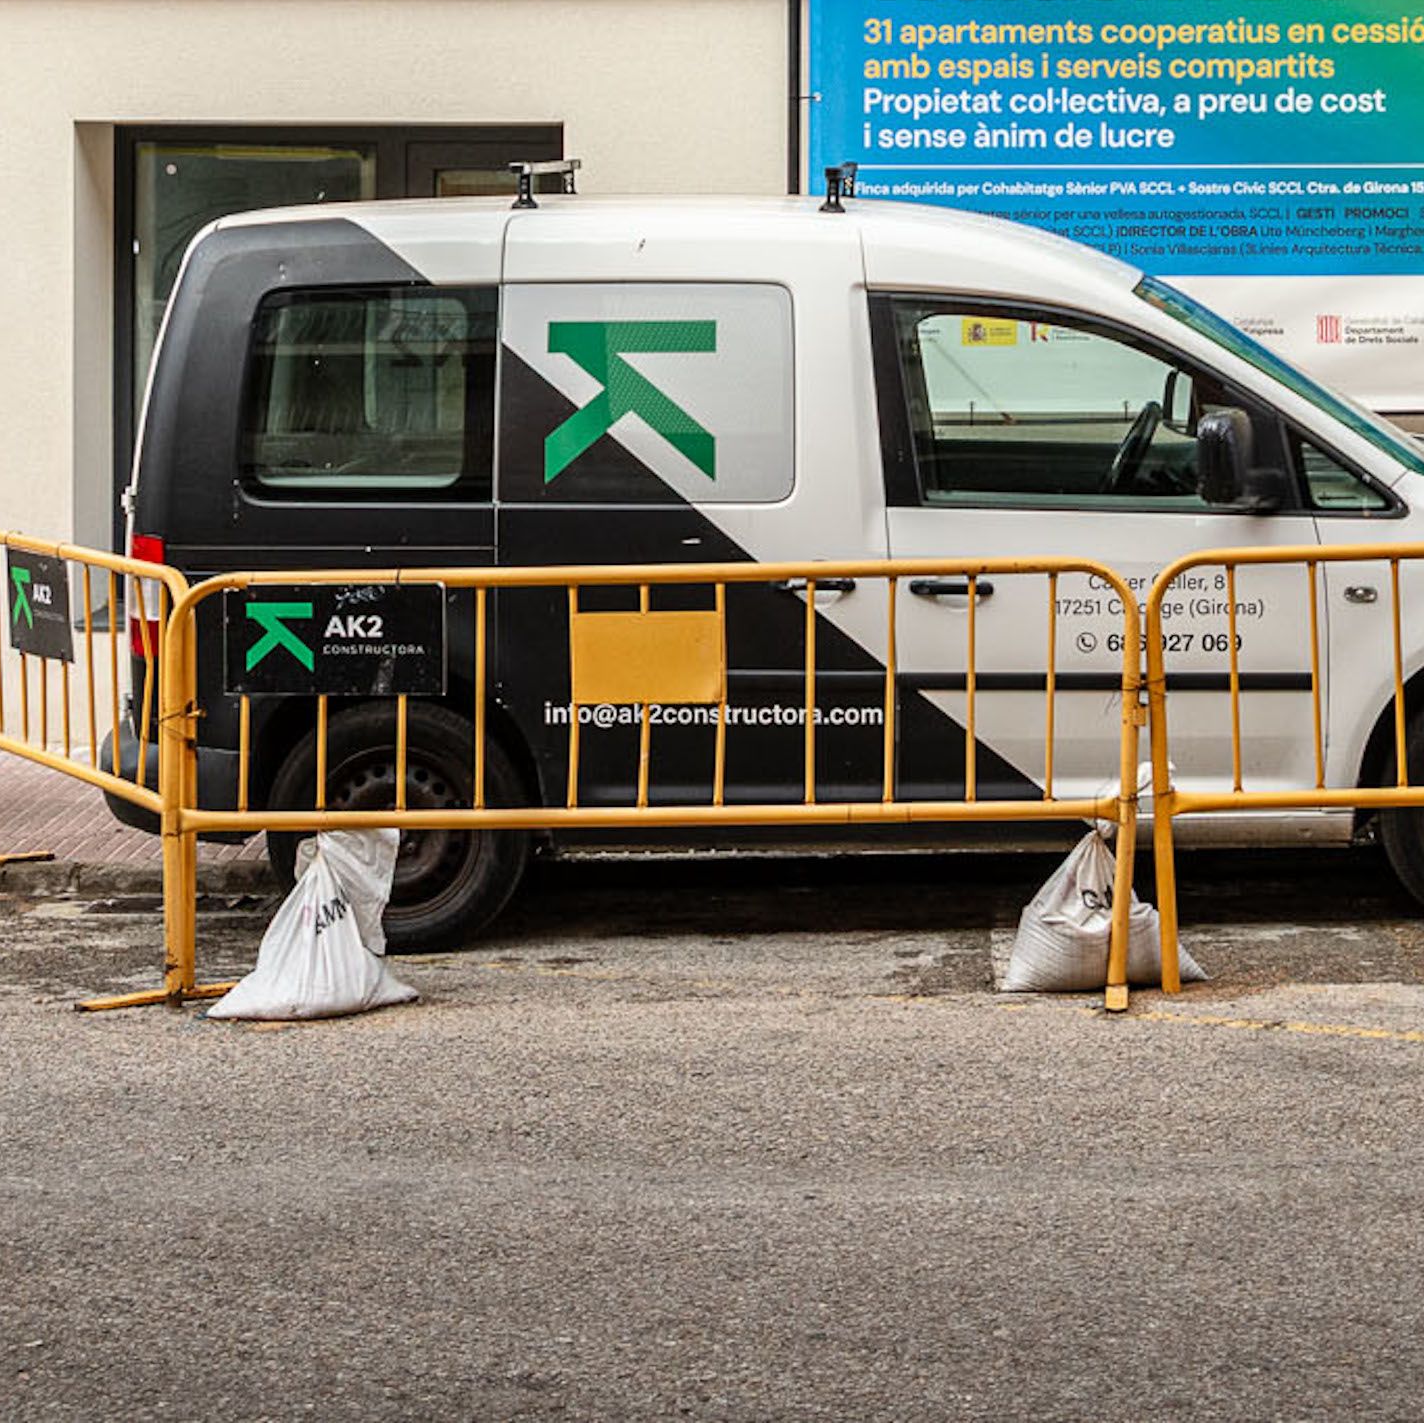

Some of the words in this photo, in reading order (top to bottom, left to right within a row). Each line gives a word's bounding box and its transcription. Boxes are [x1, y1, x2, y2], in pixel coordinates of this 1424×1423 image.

[863, 18, 892, 44] 31
[899, 20, 1094, 50] apartaments
[1101, 18, 1280, 50] cooperatius
[1287, 23, 1324, 43] en
[864, 53, 931, 79] amb
[937, 52, 1034, 86] espais
[1042, 53, 1049, 78] i
[1056, 52, 1161, 78] serveis
[1168, 52, 1335, 86] compartits
[863, 87, 1002, 121] Propietat
[1009, 87, 1166, 117] col·lectiva,
[1173, 94, 1190, 113] a
[1198, 93, 1267, 121] preu
[1274, 87, 1313, 113] de
[1320, 89, 1386, 113] cost
[864, 122, 871, 148] i
[878, 127, 966, 148] sense
[974, 122, 1046, 148] ànim
[1054, 122, 1092, 148] de
[1100, 122, 1174, 148] lucre
[855, 182, 889, 195] Finca
[893, 182, 954, 197] adquirida
[957, 184, 979, 197] per
[982, 182, 1063, 198] Cohabitatge
[1066, 182, 1108, 195] Sènior
[1110, 182, 1136, 195] PVA
[1139, 182, 1176, 195] SCCL
[1189, 182, 1230, 194] Sostre
[1268, 182, 1303, 194] SCCL
[1306, 182, 1340, 194] Ctra.
[1344, 182, 1360, 194] de
[1364, 182, 1408, 194] Girona
[1189, 225, 1206, 237] DE
[1214, 574, 1225, 590] 8
[323, 615, 384, 638] AK2
[322, 644, 425, 655] CONSTRUCTORA
